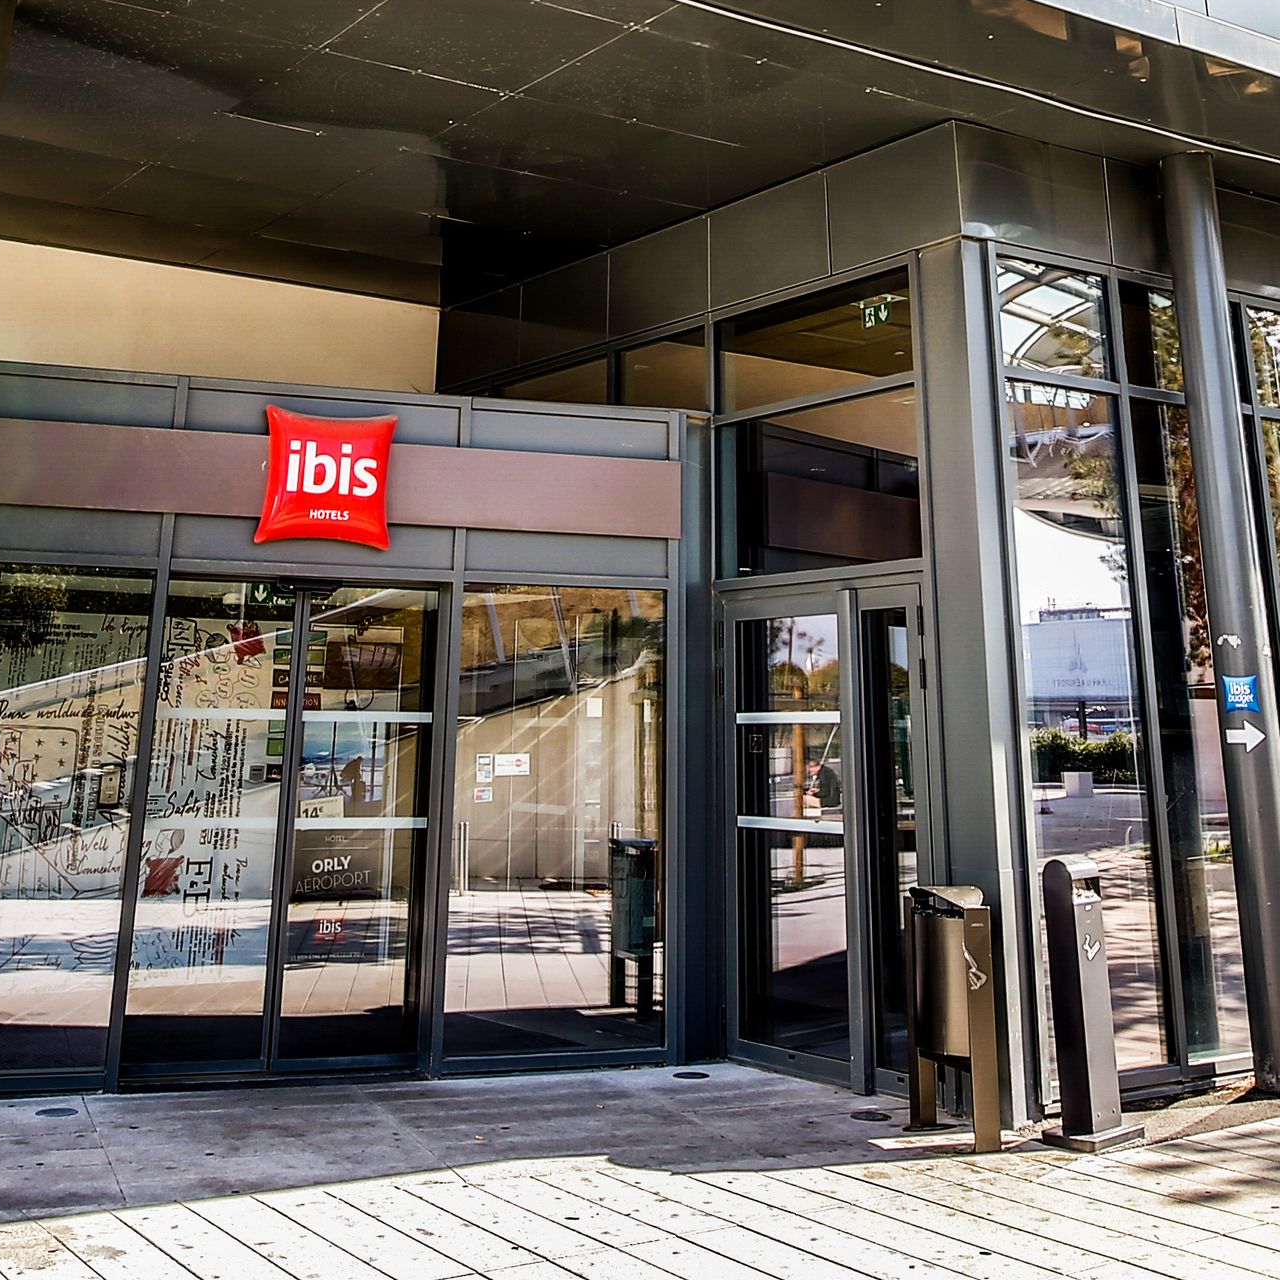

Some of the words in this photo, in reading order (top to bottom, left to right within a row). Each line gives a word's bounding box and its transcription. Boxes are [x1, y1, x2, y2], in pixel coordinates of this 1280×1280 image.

[285, 439, 378, 497] ibis
[309, 509, 350, 520] HOTELS
[1229, 681, 1251, 695] ibis
[1228, 693, 1254, 703] budget
[311, 855, 352, 874] ORLY
[295, 870, 371, 895] AÉROPORT
[319, 919, 342, 934] ibis
